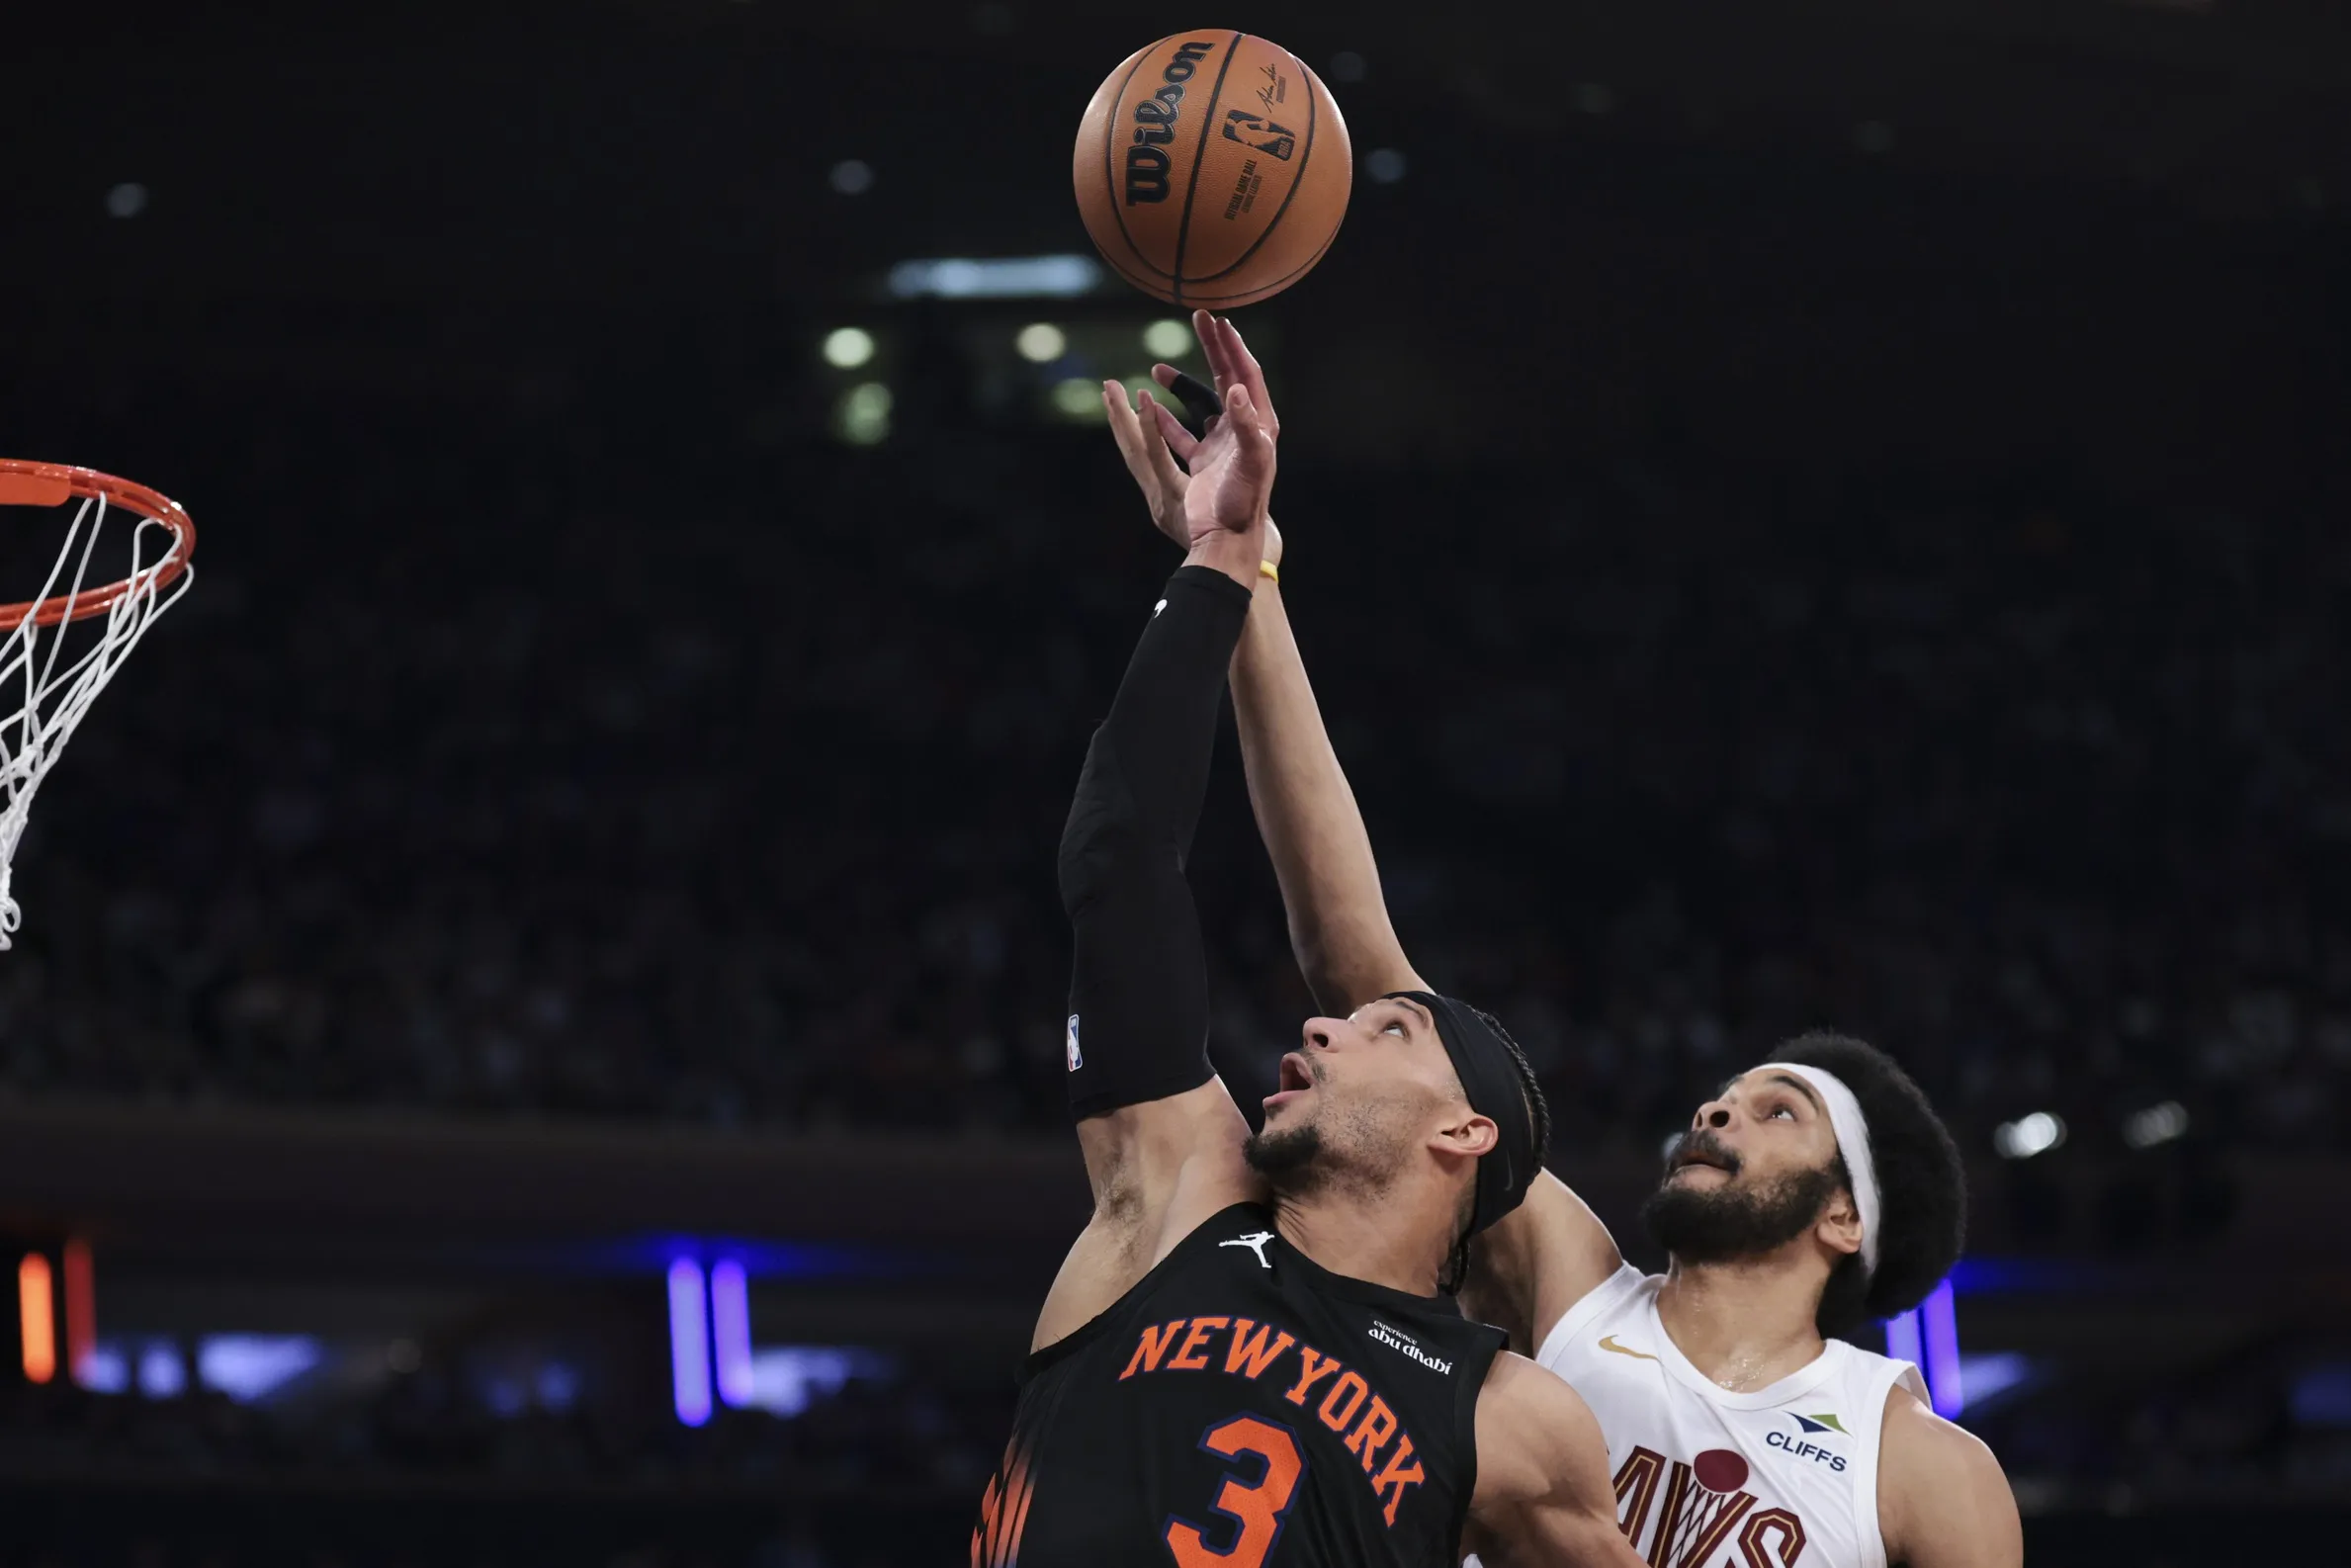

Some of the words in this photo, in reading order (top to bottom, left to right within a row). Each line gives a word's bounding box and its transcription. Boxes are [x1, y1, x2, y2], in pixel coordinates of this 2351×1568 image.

[1126, 42, 1215, 207] Wilson
[1367, 1328, 1401, 1350] abu
[1402, 1345, 1453, 1375] dhabi
[1373, 1320, 1418, 1345] experience
[1117, 1315, 1295, 1382] NEW
[1284, 1345, 1426, 1528] YORK
[1766, 1432, 1847, 1472] CLIFFS
[1161, 1409, 1310, 1568] 3
[1608, 1444, 1807, 1568] AVS
